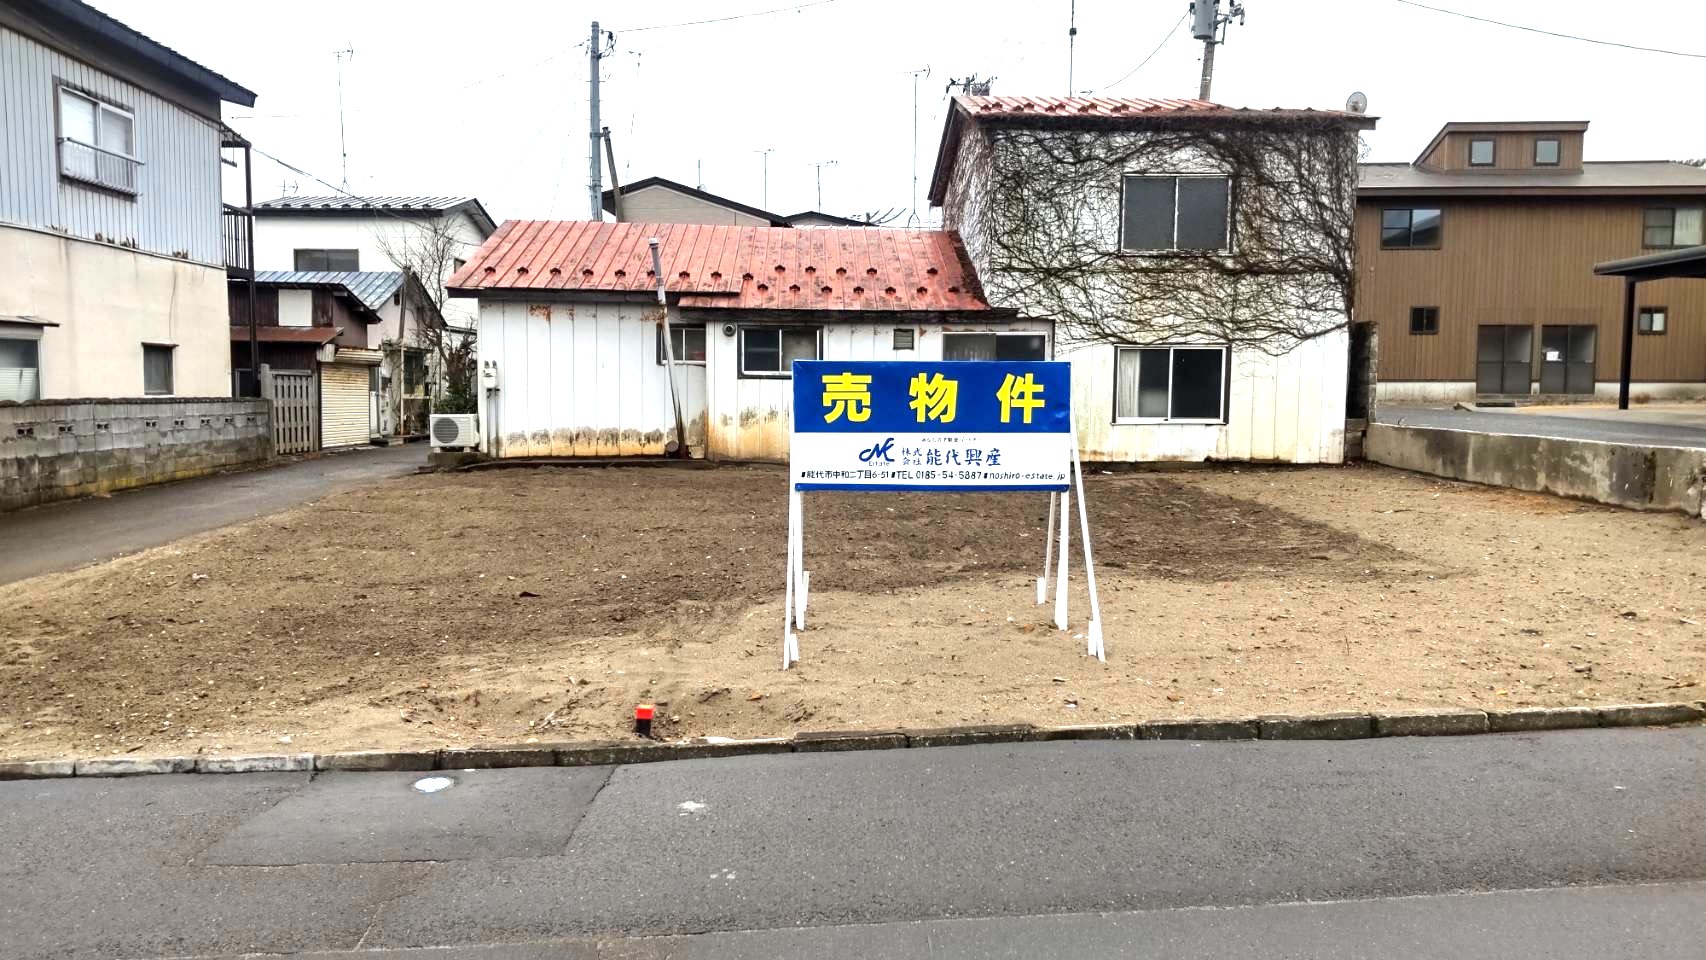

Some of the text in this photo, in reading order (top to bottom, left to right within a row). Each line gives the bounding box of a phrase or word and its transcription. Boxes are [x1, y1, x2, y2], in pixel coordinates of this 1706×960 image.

[822, 372, 1045, 423] 売物件
[926, 448, 1002, 466] 能代興産
[896, 471, 913, 479] TEL
[916, 471, 982, 480] 0185-54-5887
